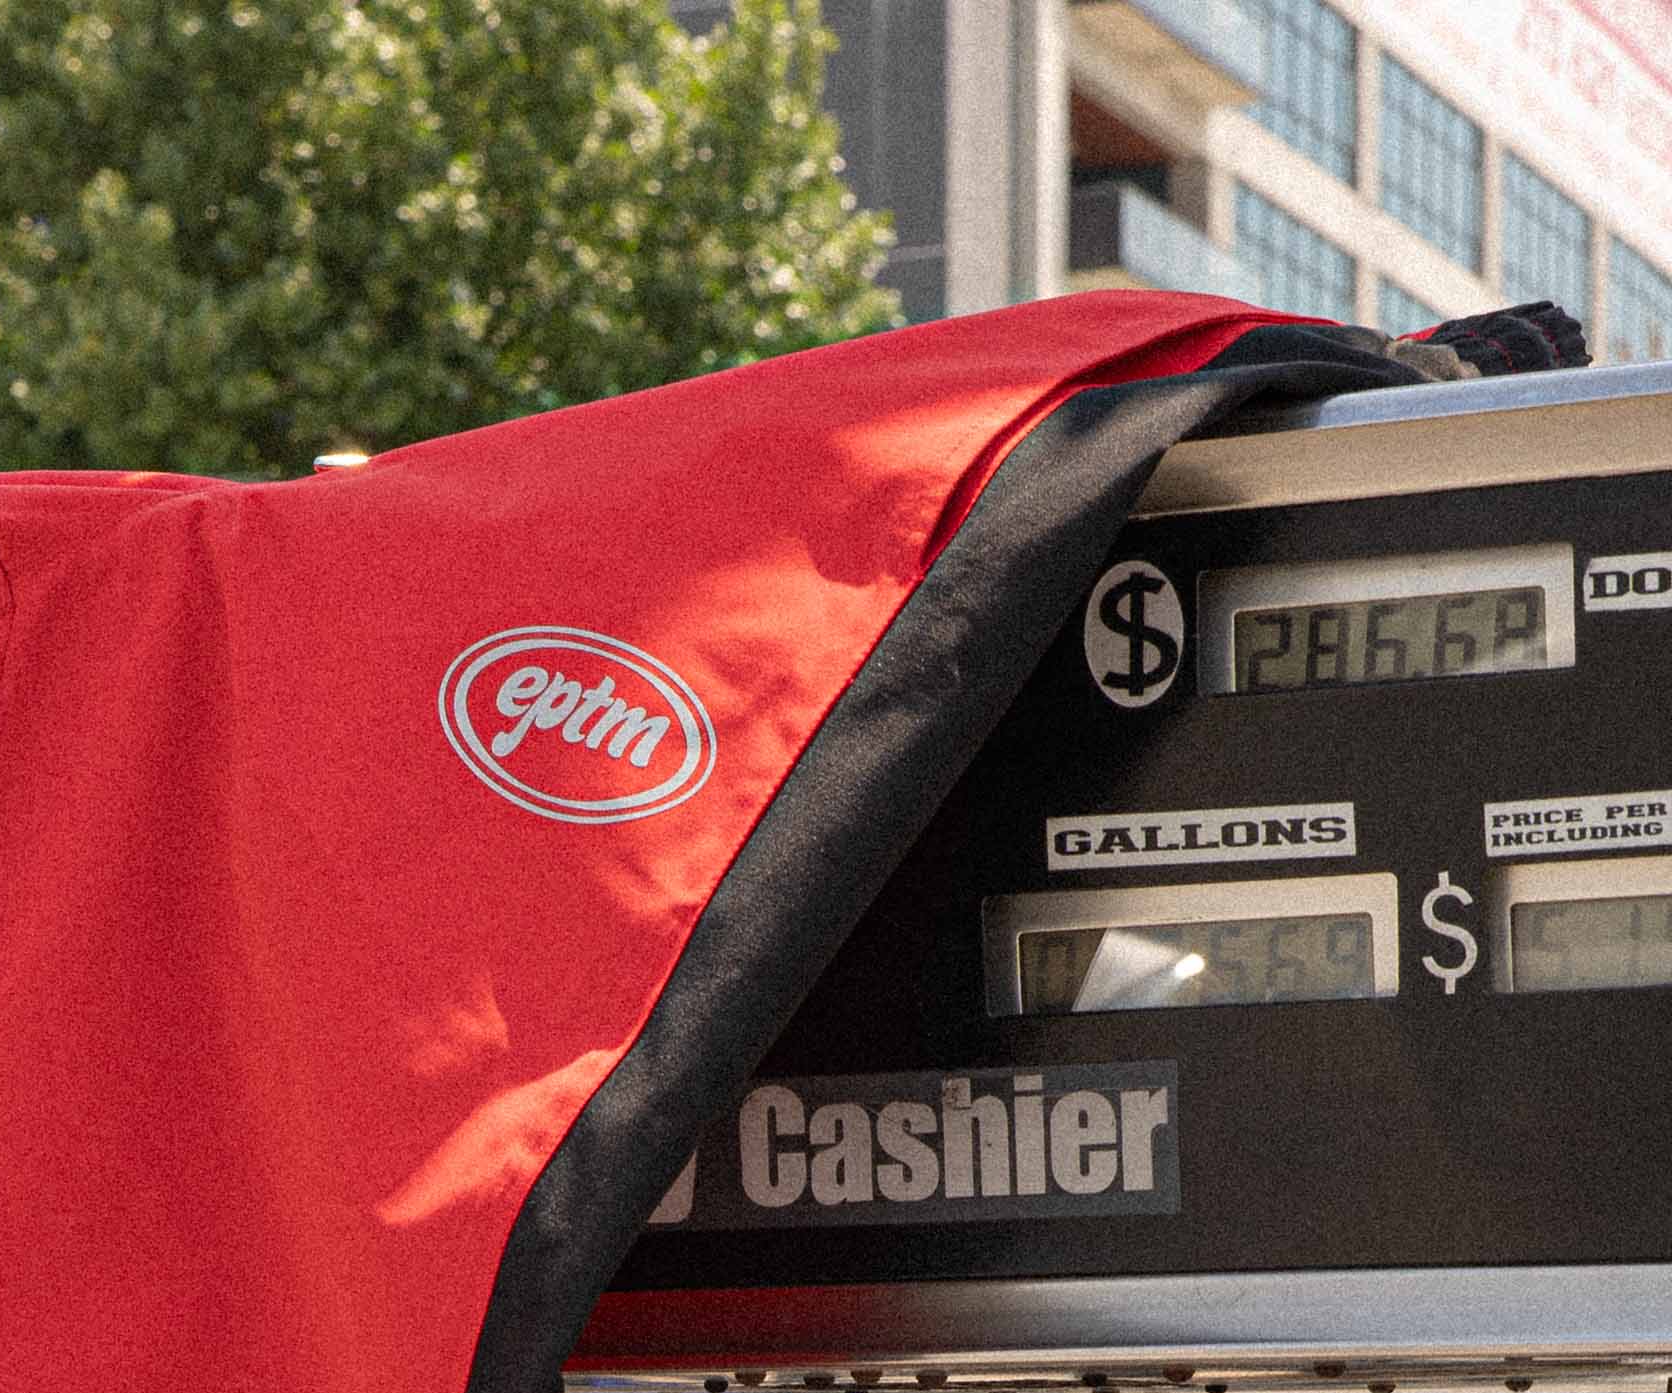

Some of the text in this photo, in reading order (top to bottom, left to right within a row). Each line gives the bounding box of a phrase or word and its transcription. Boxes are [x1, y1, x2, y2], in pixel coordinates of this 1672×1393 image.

[491, 665, 671, 768] eptm
[1053, 815, 1348, 858] GALLONS
[1491, 802, 1668, 829] PRICE PER
[1491, 821, 1665, 847] INCLUDING
[738, 1073, 1169, 1209] Cashier
